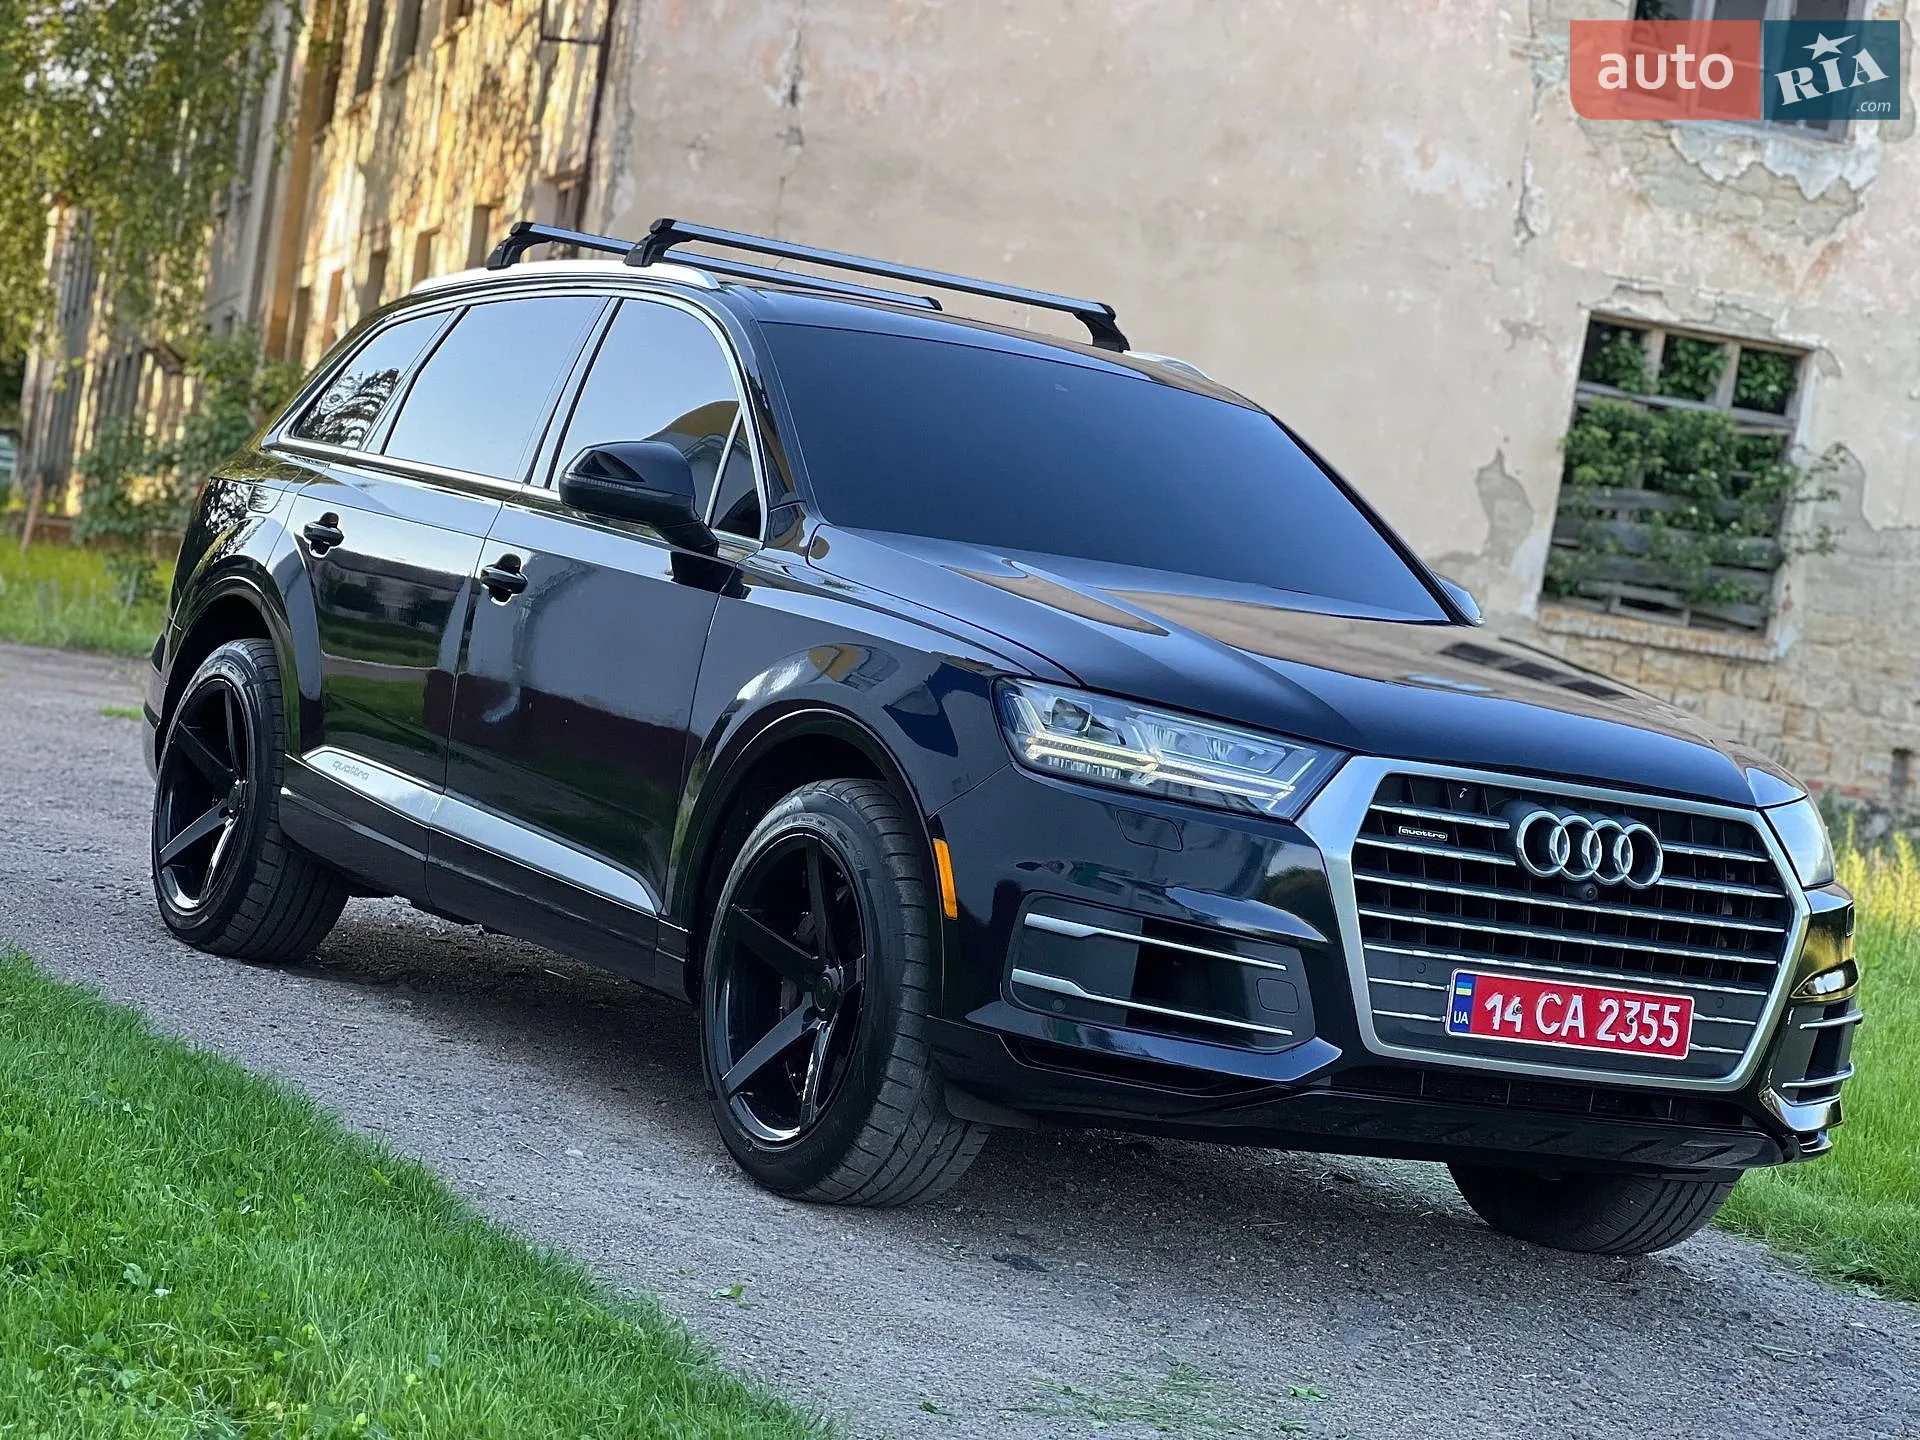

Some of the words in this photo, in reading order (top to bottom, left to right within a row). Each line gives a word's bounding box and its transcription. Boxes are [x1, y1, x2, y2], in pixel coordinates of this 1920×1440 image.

[332, 760, 370, 781] quattro
[1401, 827, 1446, 839] quattro
[1453, 1010, 1469, 1025] UA
[1484, 991, 1523, 1033] 14
[1535, 992, 1586, 1039] CA
[1596, 998, 1681, 1048] 2355
